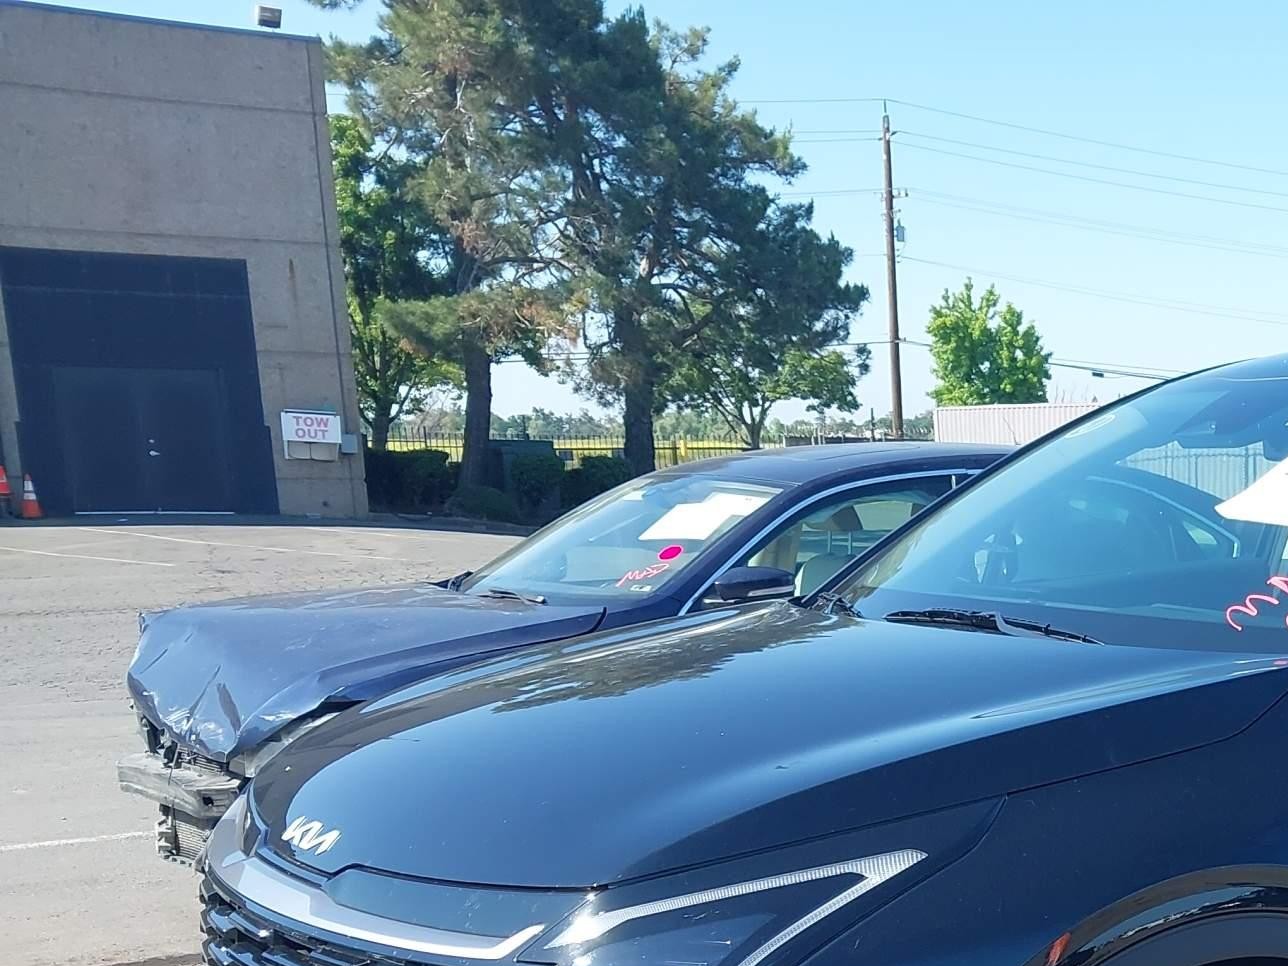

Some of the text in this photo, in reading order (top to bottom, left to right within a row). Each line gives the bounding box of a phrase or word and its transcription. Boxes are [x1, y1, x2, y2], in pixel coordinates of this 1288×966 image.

[293, 415, 329, 428] TOW
[295, 428, 328, 440] OUT
[281, 815, 342, 857] KIA
